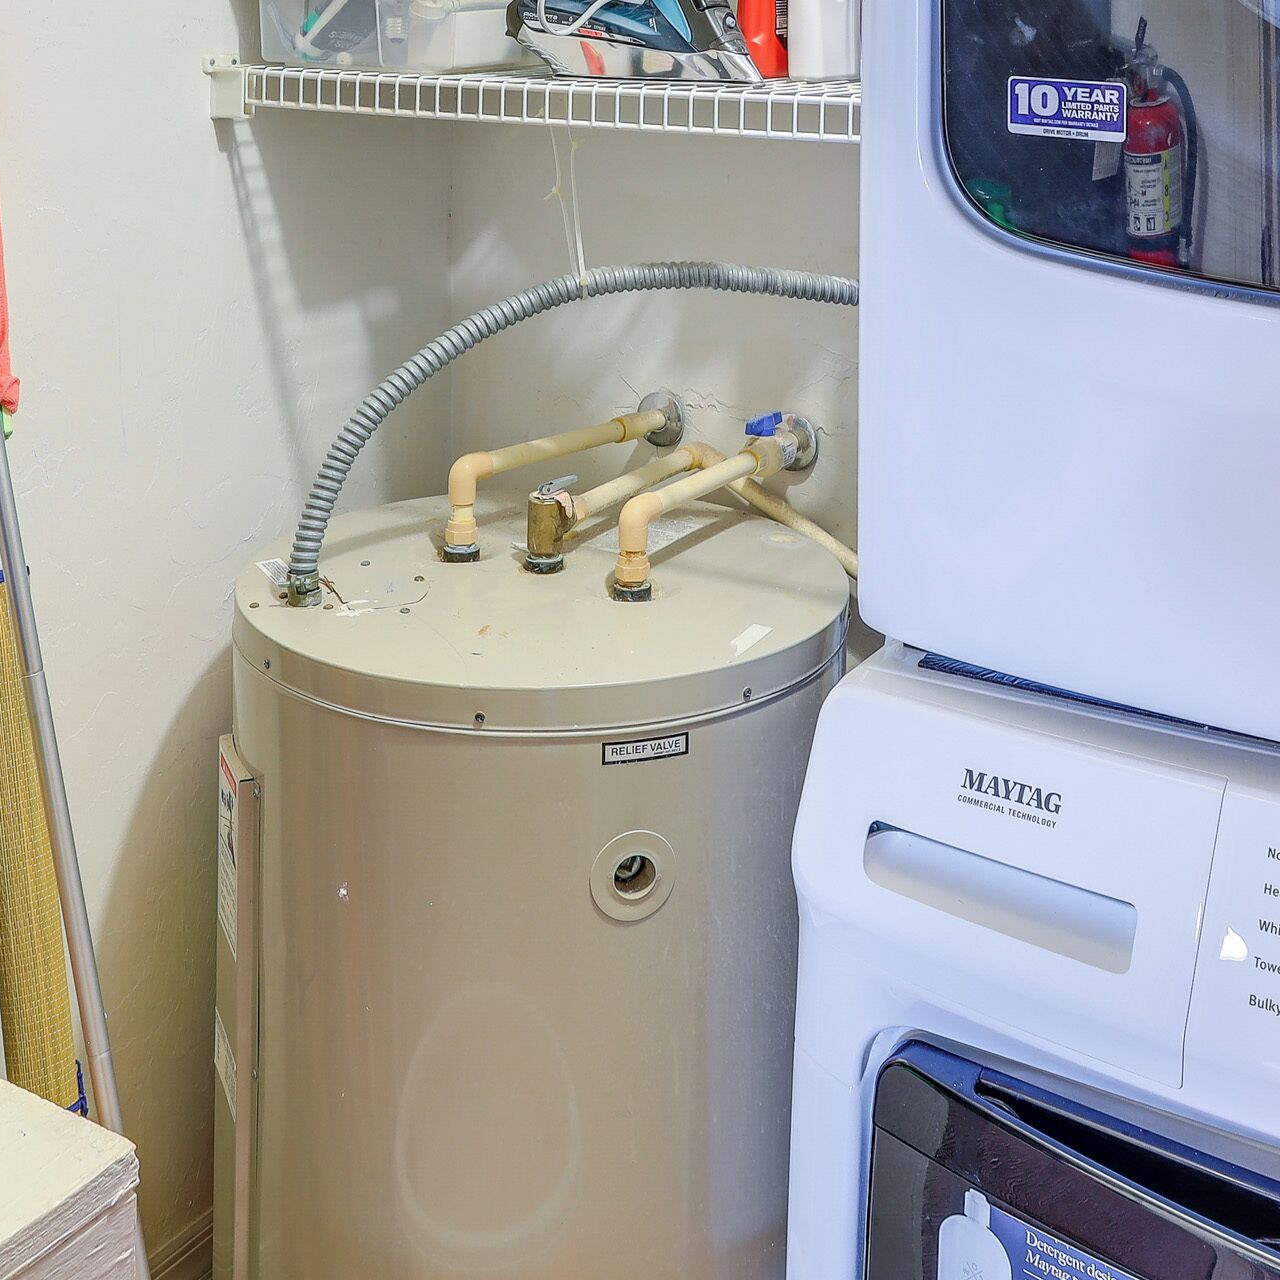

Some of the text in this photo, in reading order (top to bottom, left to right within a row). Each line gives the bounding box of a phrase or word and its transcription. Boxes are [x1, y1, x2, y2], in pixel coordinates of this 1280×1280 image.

[1014, 82, 1119, 117] 10 YEAR
[1061, 101, 1119, 113] LIMITED PARTS
[1061, 109, 1119, 122] WARRANTY
[611, 744, 648, 756] RELIEF
[650, 739, 681, 752] VALVE
[961, 768, 1062, 815] MAYTAG
[957, 794, 1057, 829] COMMERCIAL TECHNOLOGY
[1025, 1230, 1086, 1273] Detergent
[1025, 1250, 1072, 1280] Maytag
